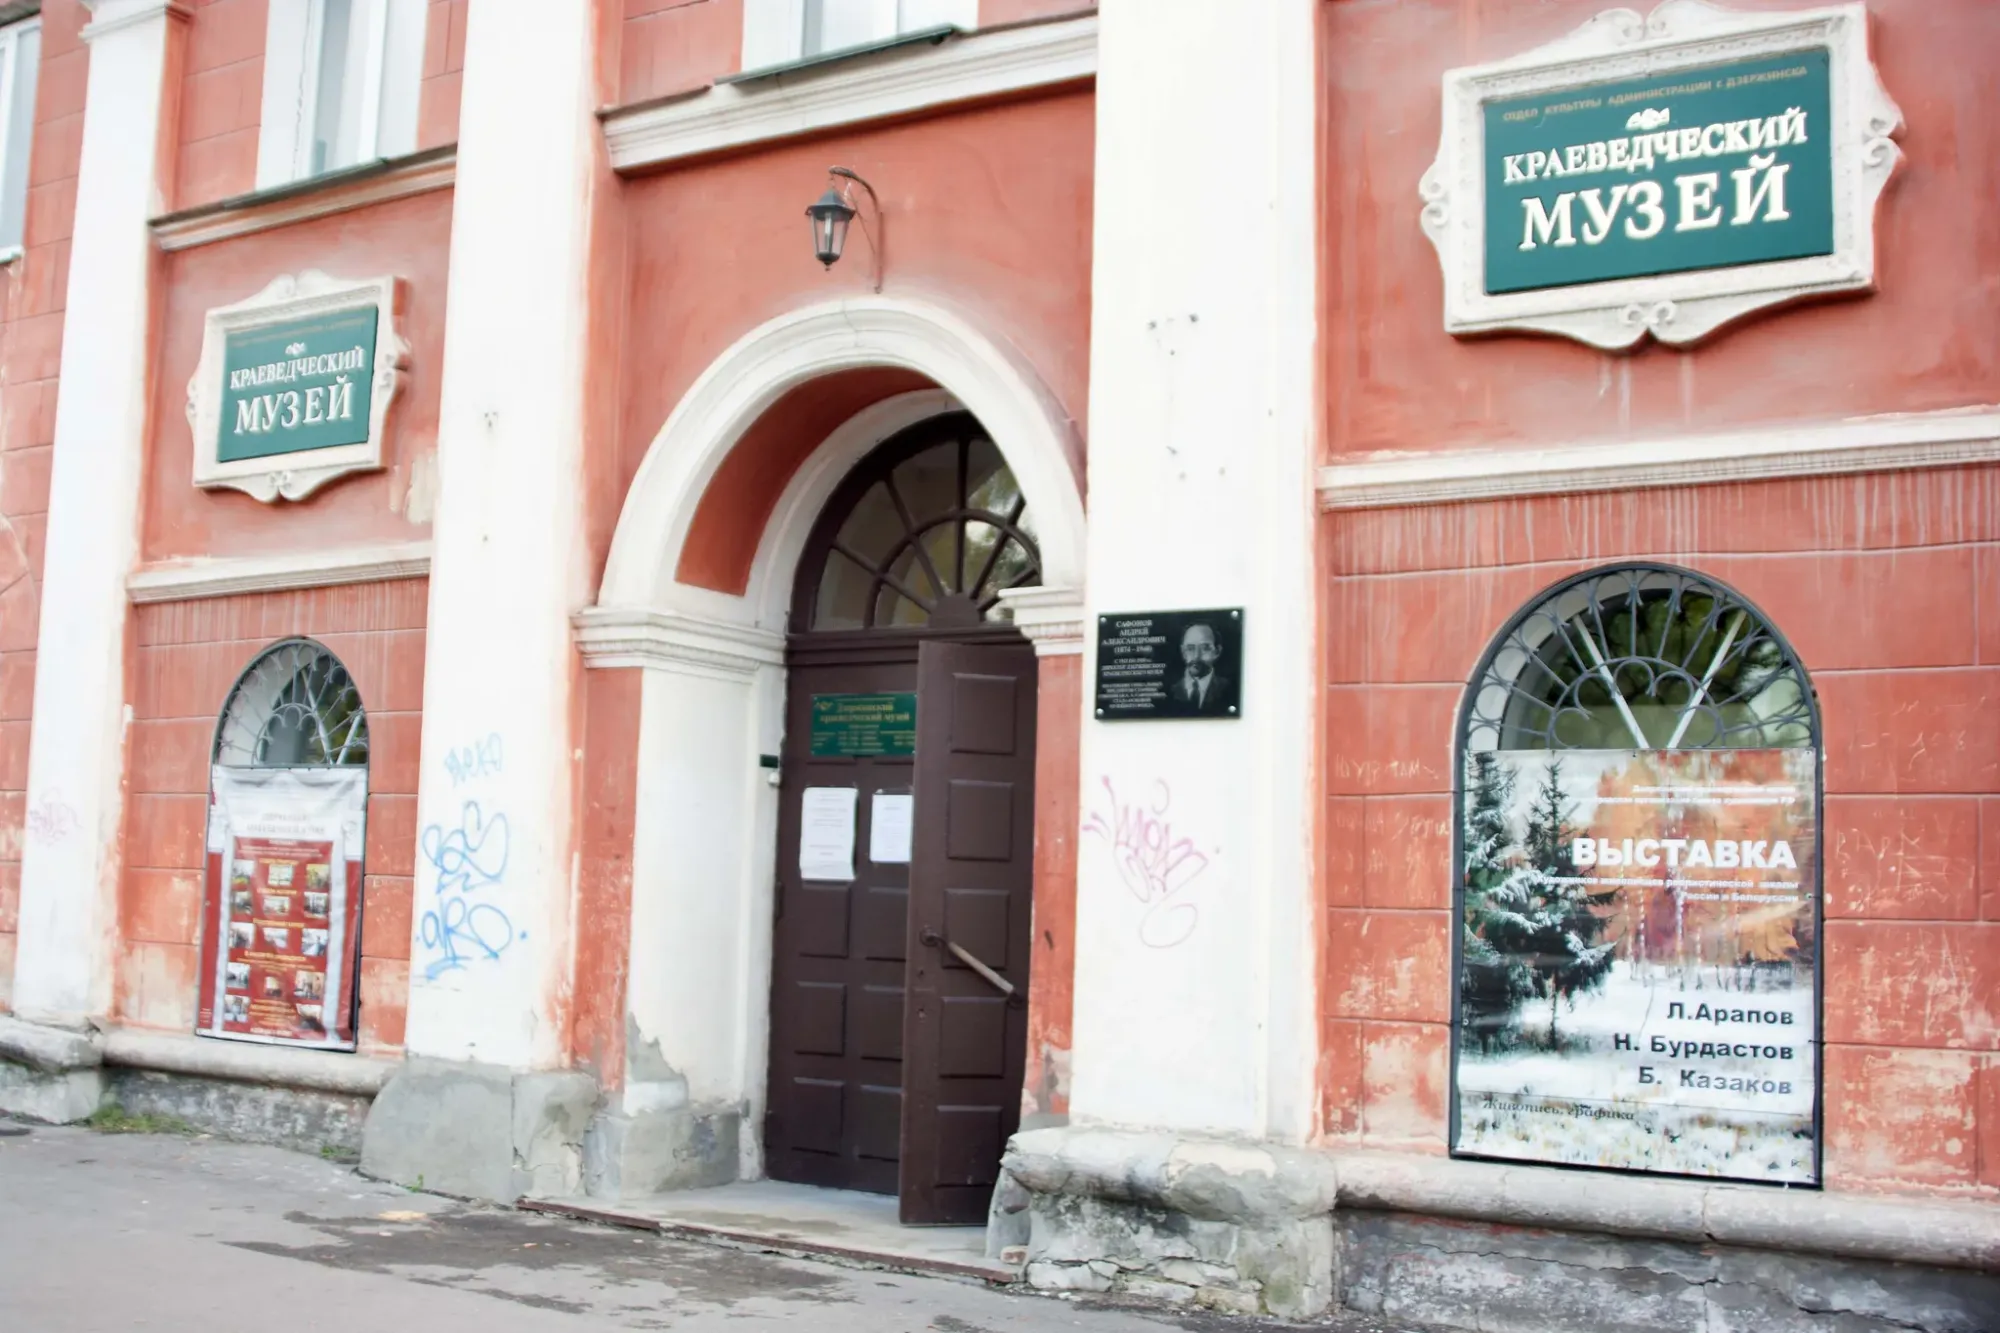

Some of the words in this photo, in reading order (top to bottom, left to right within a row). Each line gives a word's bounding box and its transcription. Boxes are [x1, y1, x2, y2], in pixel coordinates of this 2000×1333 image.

[1504, 107, 1807, 184] КРАЕВЕДЧЕСКИЙ
[1518, 154, 1790, 251] МУЗЕЙ
[230, 345, 365, 389] КРАЕВЕДЧЕСКИЙ
[234, 374, 353, 434] МУЗЕЙ
[1572, 839, 1797, 869] ВЫСТАВКА
[1667, 1002, 1794, 1026] Л.Арапов
[1614, 1033, 1640, 1051] Н.
[1651, 1035, 1794, 1060] Бурдастов
[1639, 1066, 1662, 1085] Б.
[1680, 1069, 1792, 1094] Казаков
[1567, 1106, 1635, 1120] графика
